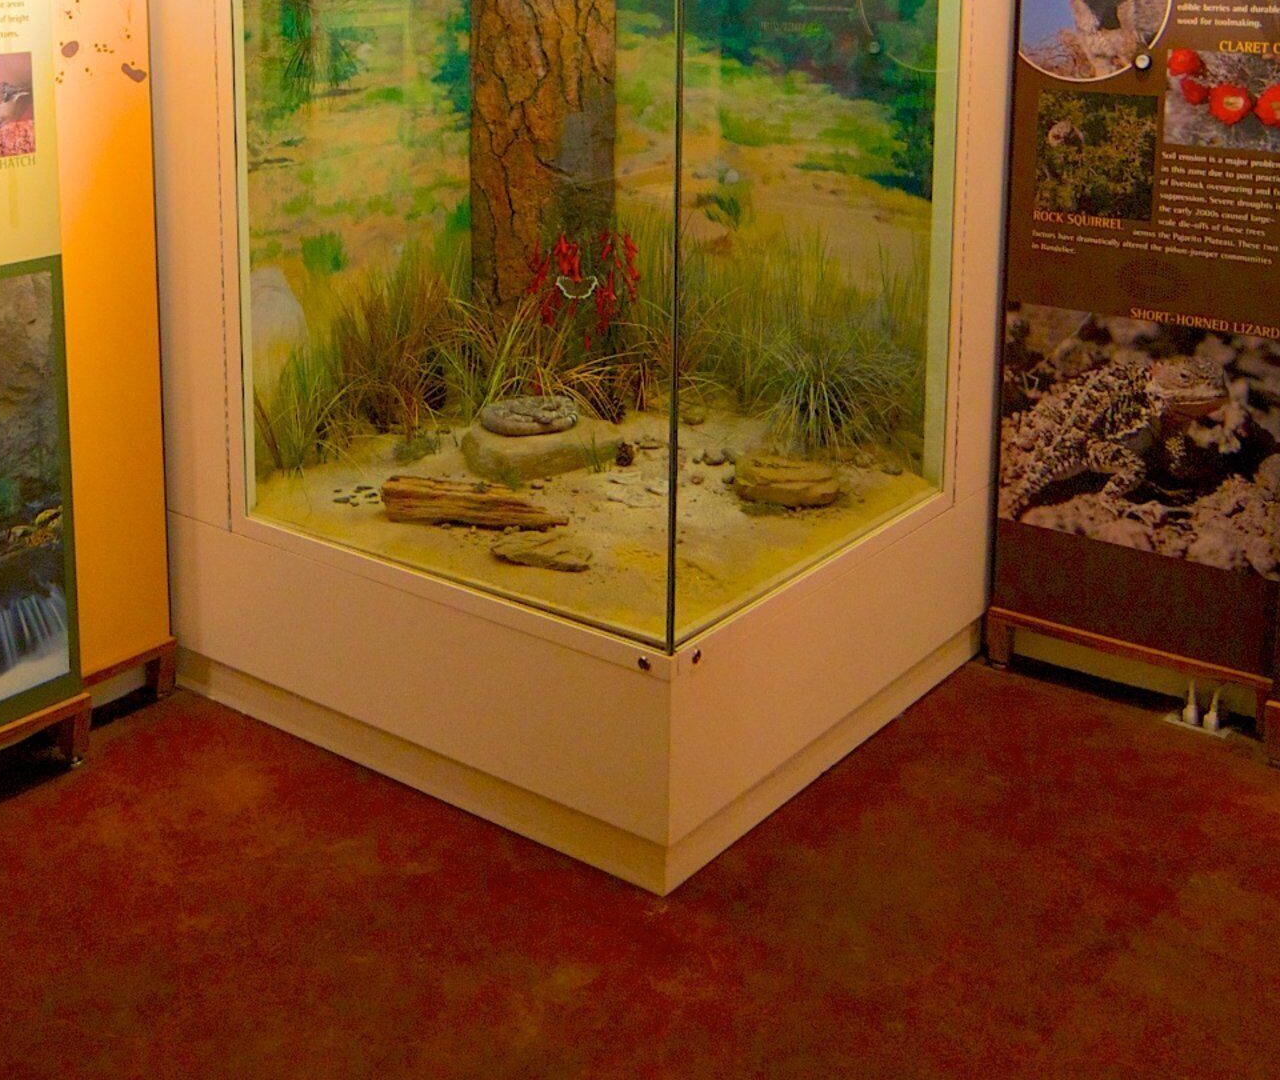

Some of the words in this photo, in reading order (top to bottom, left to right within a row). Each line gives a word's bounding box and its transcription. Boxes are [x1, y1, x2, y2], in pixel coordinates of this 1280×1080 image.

[1220, 41, 1269, 55] CLARET
[1033, 210, 1064, 224] ROCK
[1067, 213, 1124, 230] SQUIRREL
[1130, 307, 1229, 333] SHORT-HORNED
[1233, 320, 1280, 338] LIZARD
